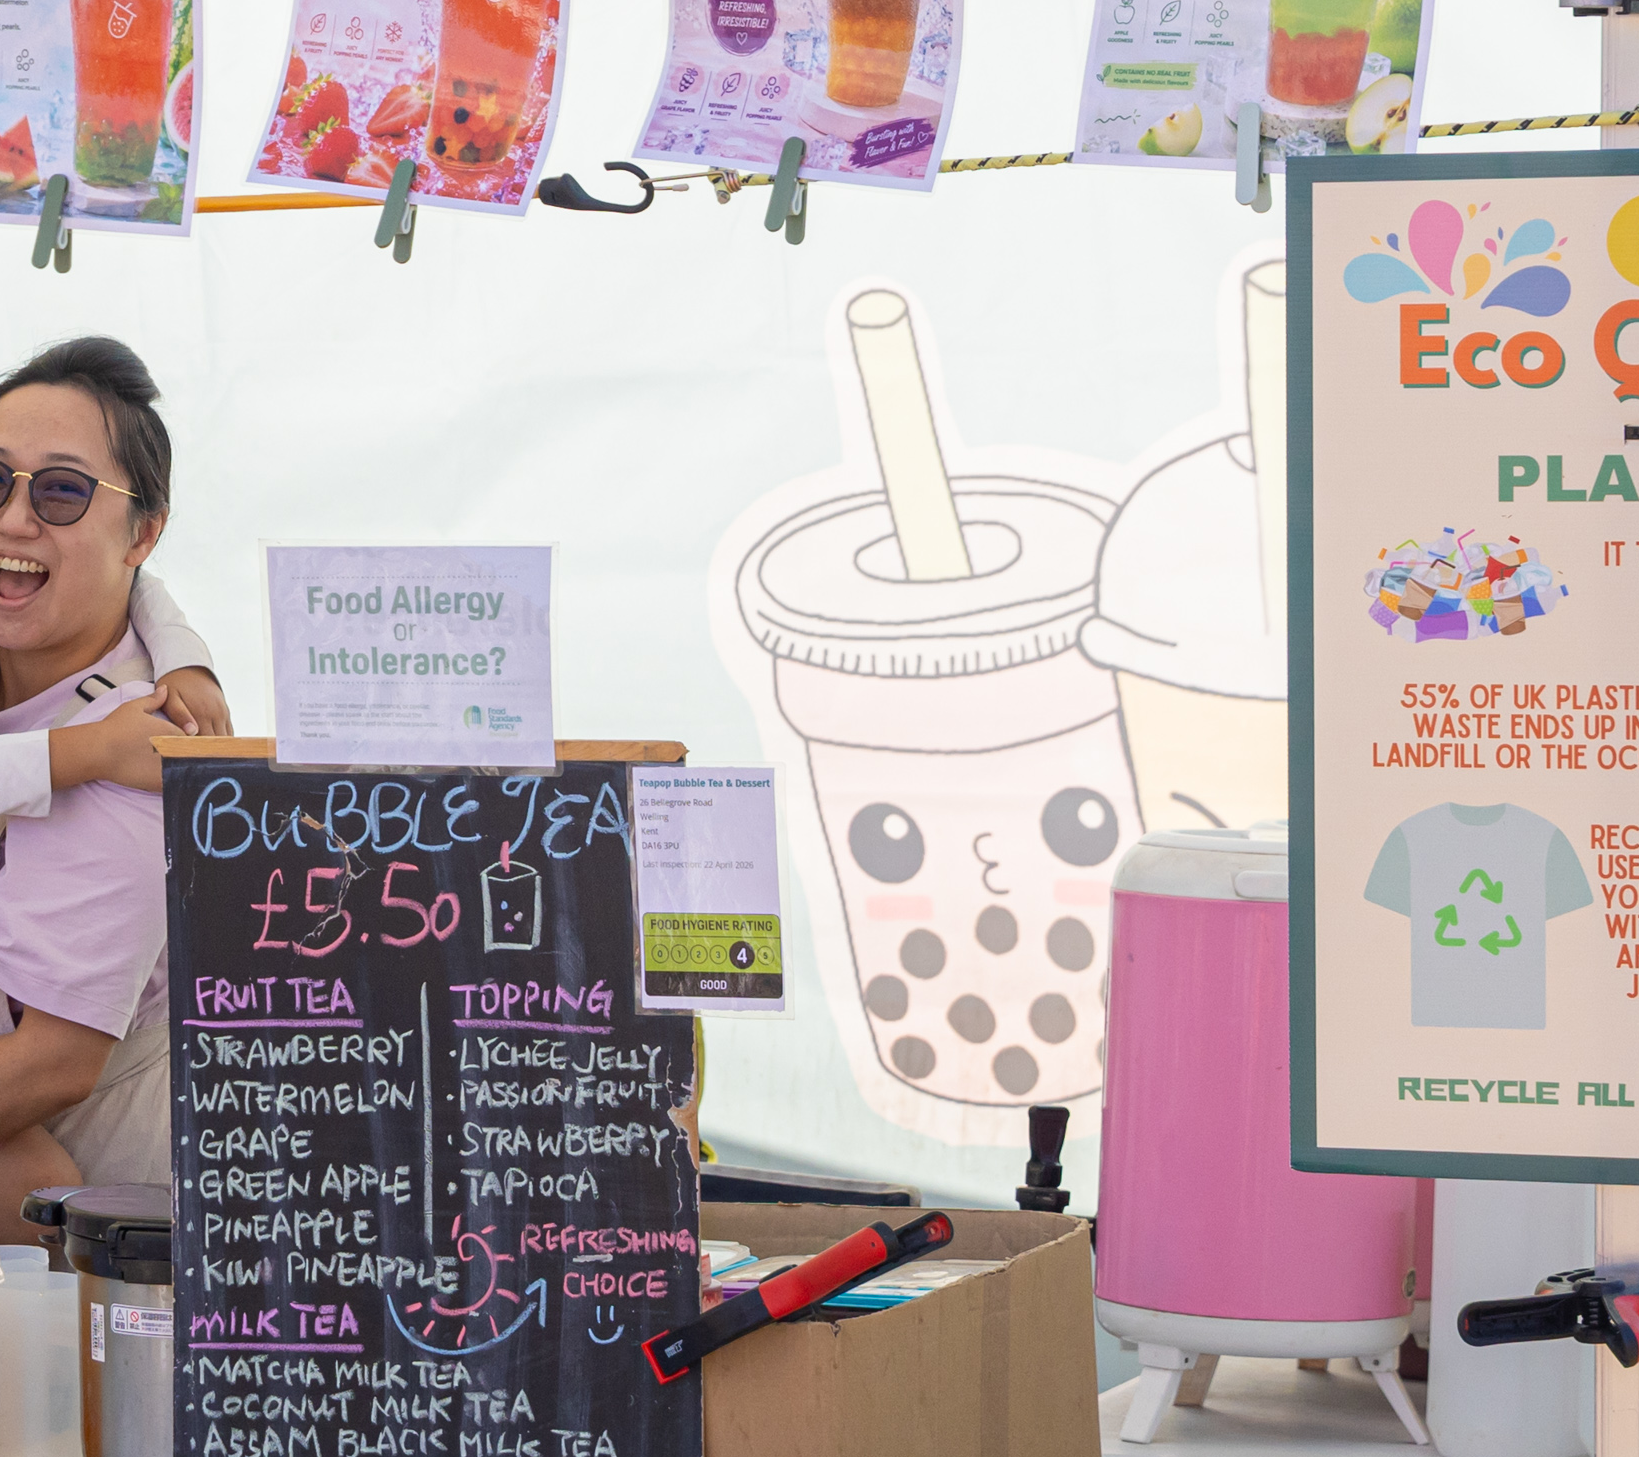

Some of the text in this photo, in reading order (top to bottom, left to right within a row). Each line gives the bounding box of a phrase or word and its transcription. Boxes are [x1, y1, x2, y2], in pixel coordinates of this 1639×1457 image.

[717, 16, 769, 29] IRRESISTIBLE!
[1115, 68, 1145, 76] CONTAINS
[1174, 70, 1191, 78] FRUIT
[1399, 302, 1567, 389] Eco
[1603, 541, 1625, 568] IT
[306, 585, 504, 621] Food Allergy
[393, 619, 416, 642] or
[308, 646, 507, 677] Intolerance?
[1399, 683, 1460, 710] 55%
[1469, 683, 1503, 710] OF
[1512, 684, 1547, 711] UK
[639, 779, 770, 789] Teapop Bubble Tea & Dessert
[503, 776, 632, 859] TEA
[250, 861, 461, 958] £5.50
[651, 919, 772, 931] FOOD HYGIENE RATING
[737, 947, 747, 963] 4
[194, 975, 356, 1015] FRUIT TEA
[449, 979, 614, 1018] TOPPING
[700, 980, 727, 989] GOOD
[190, 1028, 415, 1070] STRAWBERRY
[460, 1037, 661, 1075] LYCHEE JELLY
[191, 1077, 417, 1115] WATERMELON
[1398, 1076, 1559, 1104] RECYCLE
[1576, 1082, 1635, 1108] ALL
[198, 1126, 313, 1159] GRAPE
[460, 1124, 669, 1166] STRAWBERRY
[198, 1164, 412, 1205] GREEN APPLE
[460, 1167, 599, 1205] TAPIOCA
[204, 1210, 378, 1248] PINEAPPLE
[520, 1223, 697, 1255] REFRESHING
[563, 1269, 669, 1298] CHOICE
[189, 1309, 281, 1339] MILK
[289, 1301, 360, 1338] TEA
[201, 1389, 536, 1423] COCONUT MILK TEA
